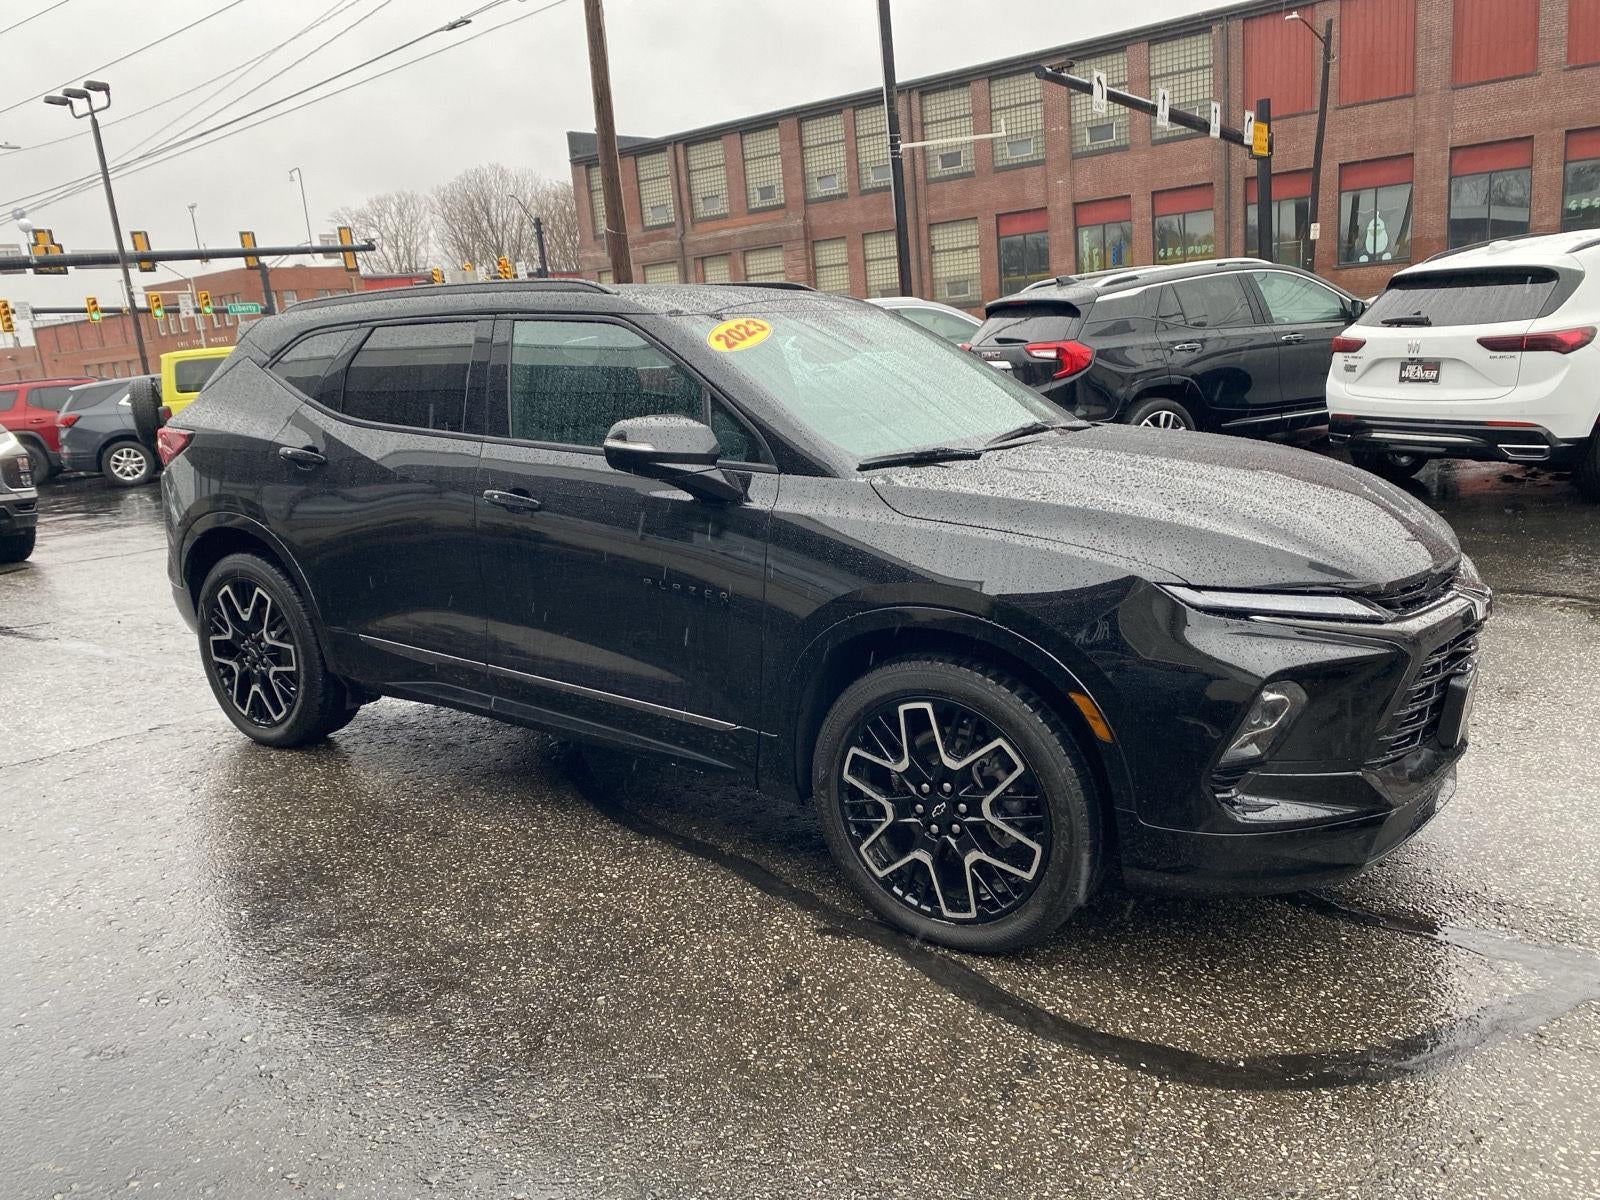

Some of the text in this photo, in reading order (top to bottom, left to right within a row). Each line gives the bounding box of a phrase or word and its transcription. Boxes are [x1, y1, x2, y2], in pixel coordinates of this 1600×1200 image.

[231, 305, 256, 314] Liberty
[714, 319, 768, 350] 2023
[1401, 370, 1438, 380] WEAVER
